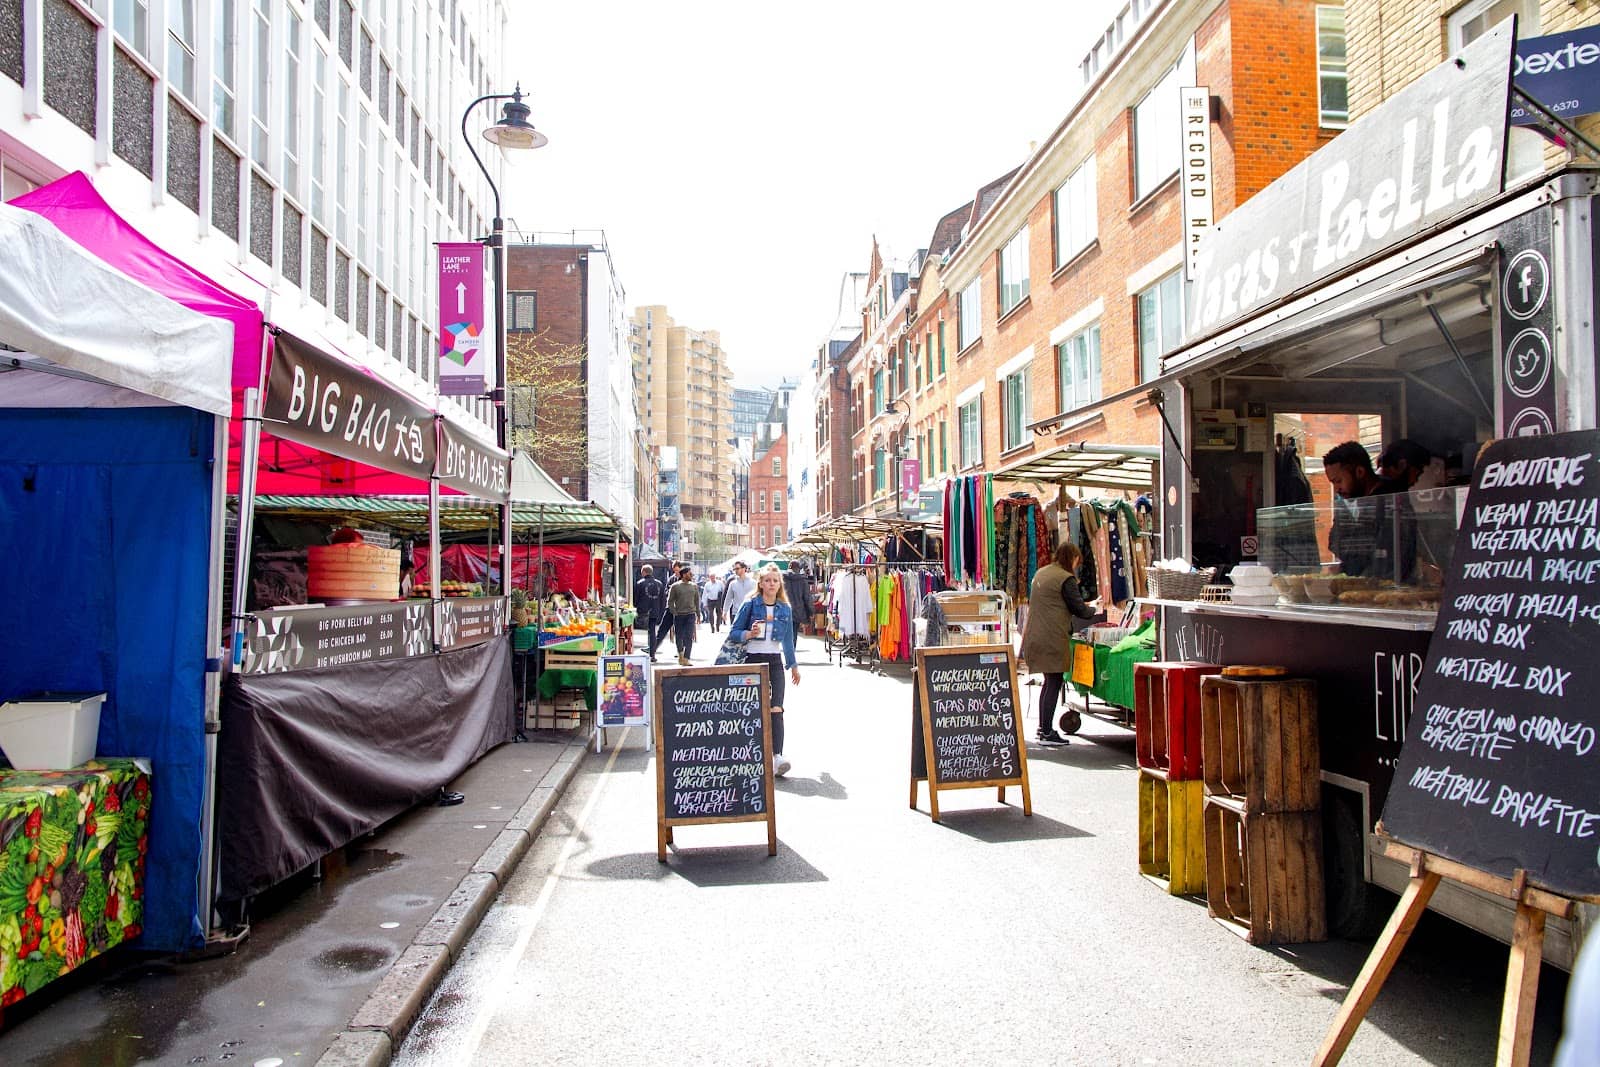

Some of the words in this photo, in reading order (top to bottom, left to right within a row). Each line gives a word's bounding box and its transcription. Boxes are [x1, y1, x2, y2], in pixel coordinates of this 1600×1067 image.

[1188, 97, 1203, 107] THE
[1552, 100, 1579, 112] 6370
[1188, 115, 1206, 198] RECORD
[442, 256, 471, 264] LEATHER
[287, 364, 342, 433] BIG
[343, 393, 391, 453] BAO
[394, 415, 424, 464] 大包
[446, 439, 466, 480] BIG
[468, 452, 489, 488] BAO
[1475, 500, 1531, 530] VEGAN
[1533, 497, 1599, 527] PAELLA
[1471, 526, 1577, 556] VEGETARIAN
[1463, 556, 1533, 582] TORTILLA
[1454, 592, 1514, 617] CHICKEN
[1515, 593, 1578, 623] PAELLA
[319, 620, 329, 631] BIG
[331, 618, 346, 629] PORK
[347, 617, 362, 628] BELLY
[363, 615, 374, 626] BAO
[318, 638, 329, 649] BIG
[330, 634, 355, 648] CHICKEN
[356, 633, 367, 644] BAO
[1446, 618, 1491, 644] TAPAS
[1493, 623, 1532, 650] BOX
[317, 656, 328, 668] BIG
[329, 650, 361, 667] MUSHROOM
[361, 648, 372, 659] BAO
[931, 669, 971, 683] CHICKEN
[971, 667, 1001, 682] PAELLA
[1436, 656, 1520, 689] MEATBALL
[1525, 665, 1572, 696] BOX
[933, 683, 950, 692] WITH
[951, 681, 986, 692] CHORIZO
[673, 687, 721, 704] CHICKEN
[723, 686, 759, 702] PAELLA
[675, 703, 697, 713] WITH
[699, 701, 739, 714] CHORIZO
[933, 698, 965, 713] TAPAS
[967, 698, 986, 713] BOX
[675, 719, 714, 738] TAPAS
[717, 719, 741, 736] BOX
[935, 715, 982, 729] MEATBALL
[982, 713, 1000, 728] BOX
[1426, 704, 1495, 732] CHICKEN
[1519, 715, 1596, 756] CHORIZO
[936, 733, 974, 748] CHICKEN
[986, 732, 1016, 747] CHORIZO
[1421, 725, 1517, 761] BAGUETTE
[671, 746, 730, 762] MEATBALL
[731, 745, 753, 761] BOX
[940, 744, 981, 756] BAGUETTE
[673, 765, 717, 778] CHICKEN
[729, 763, 765, 778] CHORIZO
[938, 756, 992, 769] MEATBALL
[674, 774, 734, 789] BAGUETTE
[941, 767, 991, 780] BAGUETTE
[673, 787, 739, 805] MEATBALL
[1409, 766, 1491, 807] MEATBALL
[1491, 785, 1600, 838] BAGUETTE
[677, 801, 734, 815] BAGUETTE
